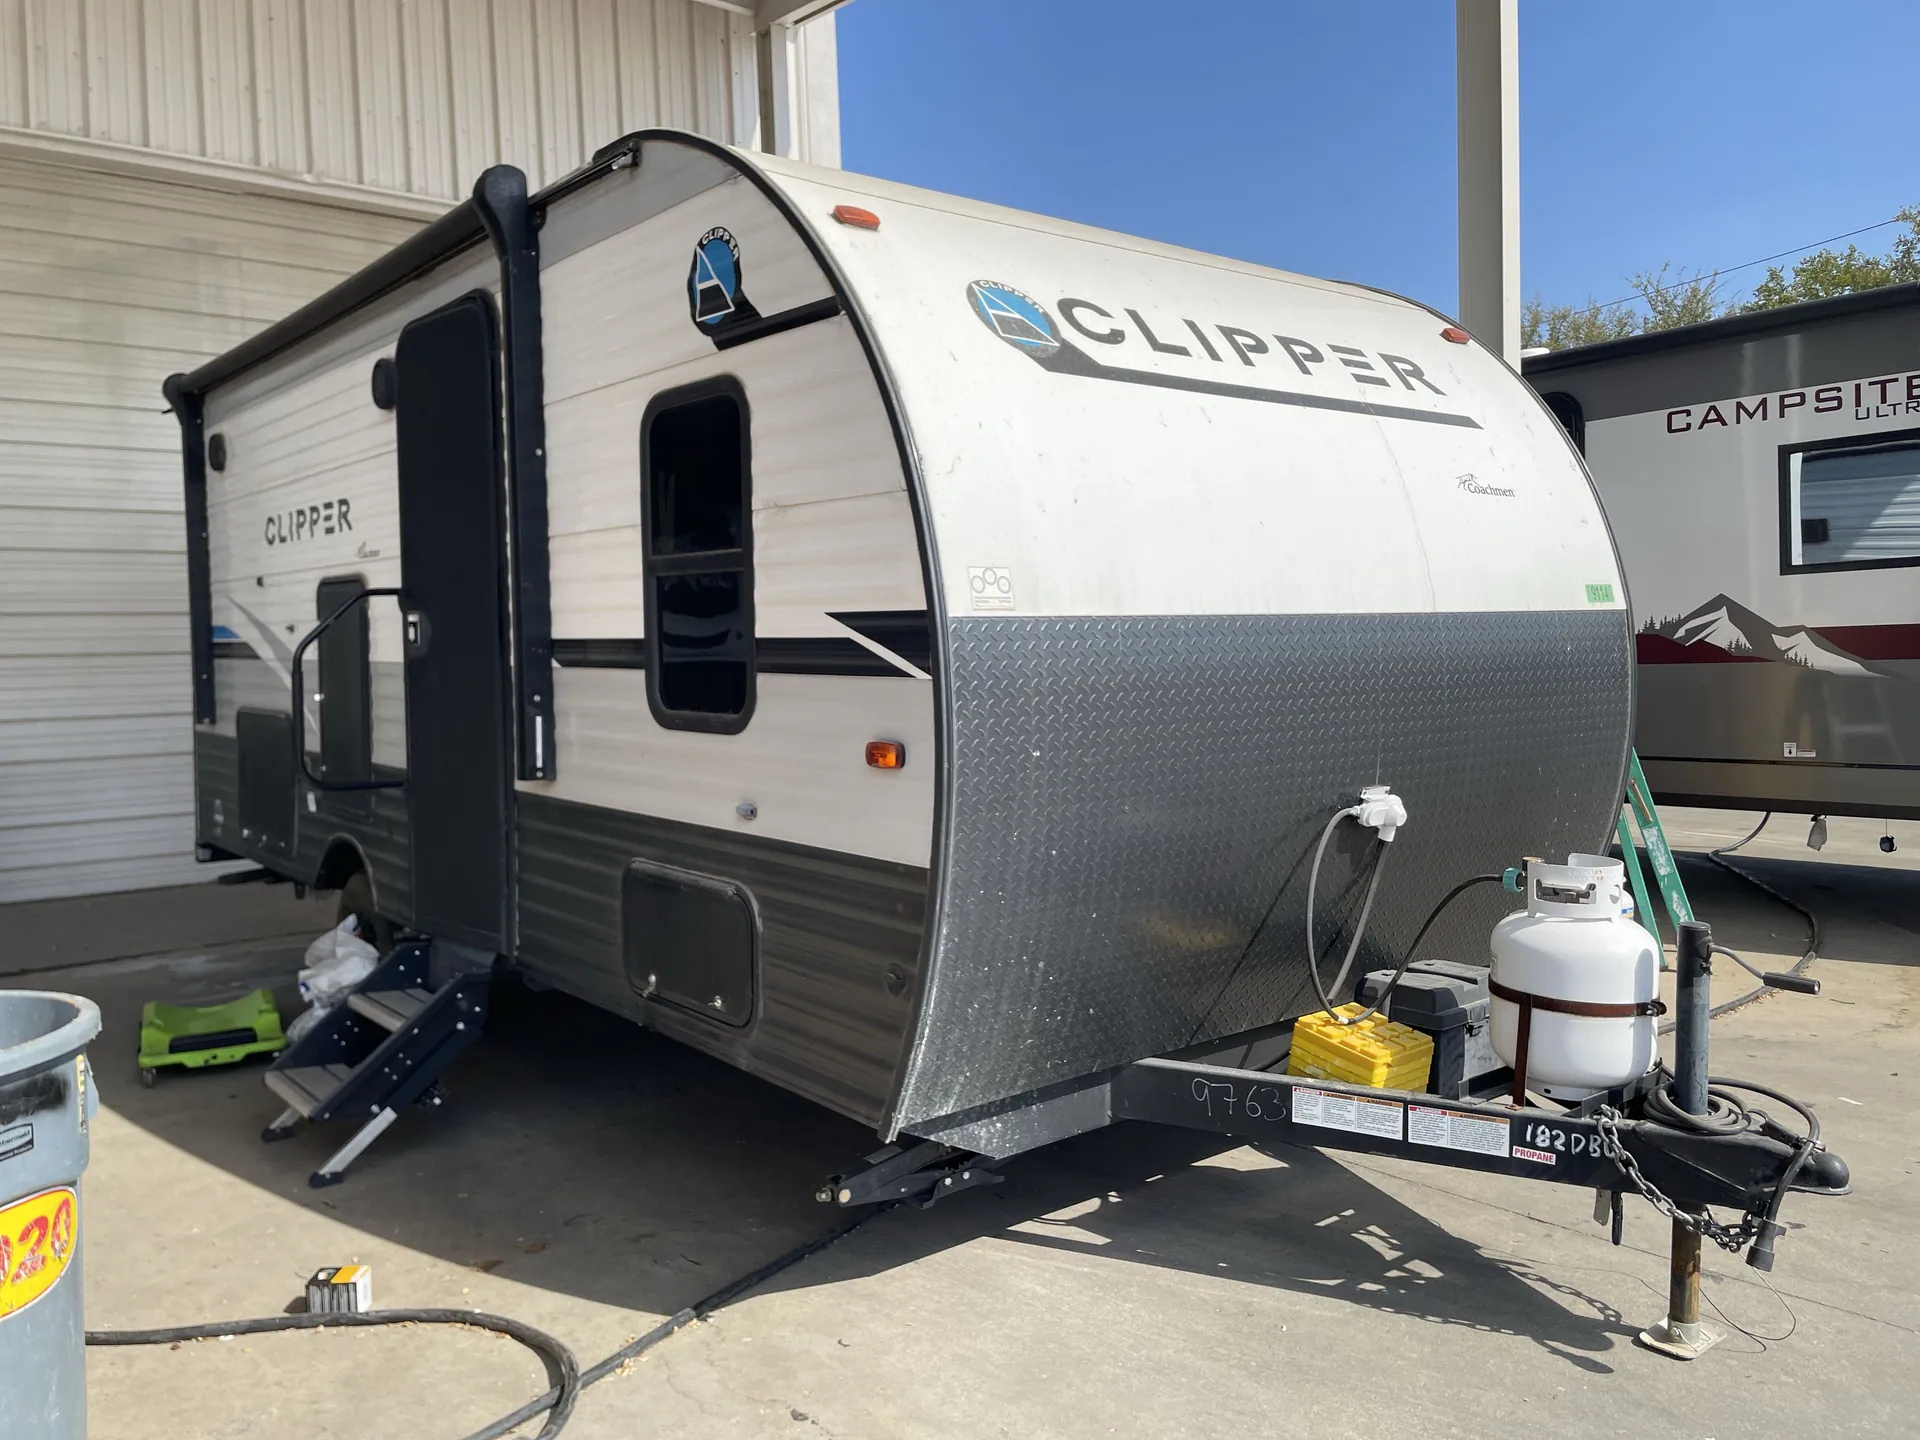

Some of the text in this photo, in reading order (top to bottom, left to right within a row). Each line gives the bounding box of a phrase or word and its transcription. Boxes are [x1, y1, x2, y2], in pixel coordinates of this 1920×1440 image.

[702, 228, 739, 261] CLIPPER
[1057, 297, 1447, 396] CLIPPER
[1666, 374, 1920, 434] CAMPSITE
[1468, 482, 1516, 497] Coachmen
[264, 498, 353, 546] CLIPPER
[1191, 1078, 1287, 1121] 9763
[1513, 1147, 1555, 1164] PROPANE
